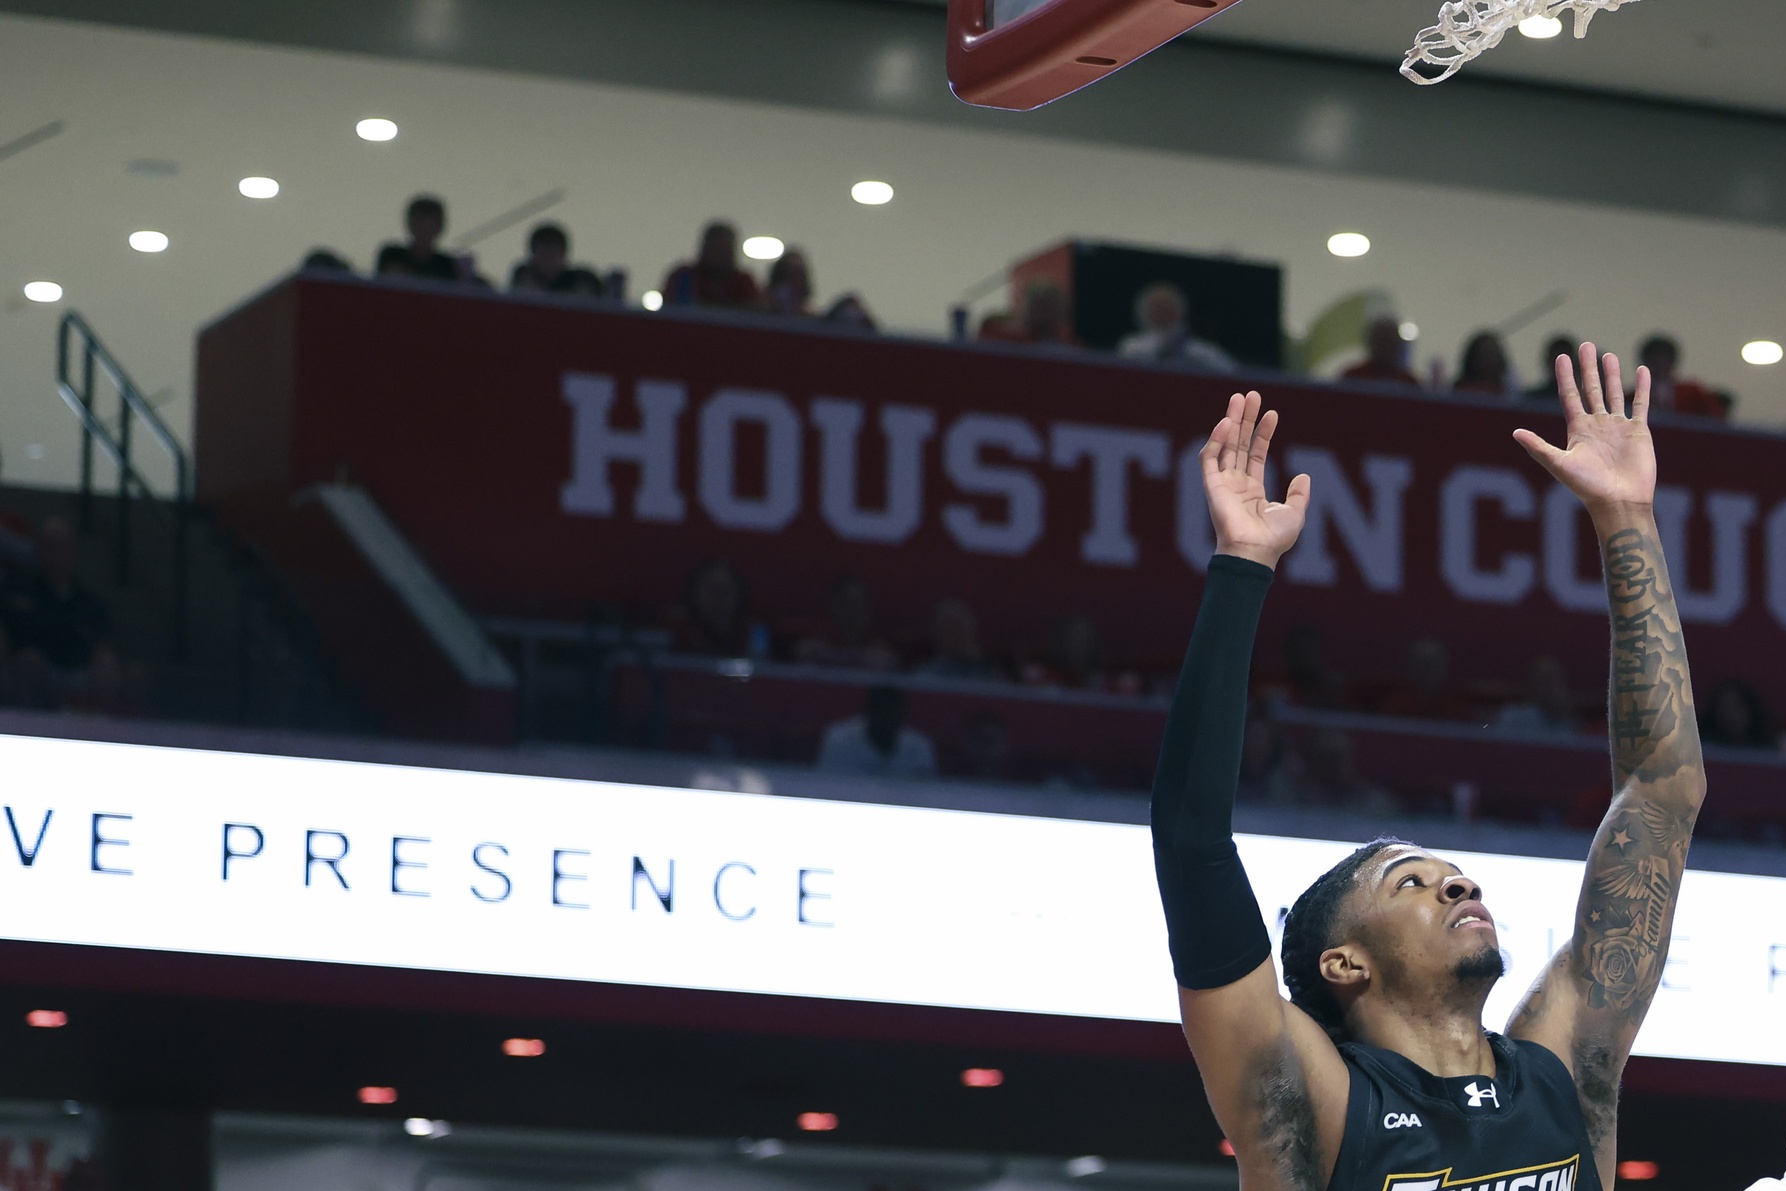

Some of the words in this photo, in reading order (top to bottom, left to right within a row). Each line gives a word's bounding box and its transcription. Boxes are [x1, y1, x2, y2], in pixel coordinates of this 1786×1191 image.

[1607, 526, 1656, 604] GOD
[1614, 604, 1658, 694] FEAR
[222, 821, 836, 928] PRESENCE
[1383, 1112, 1423, 1130] CAA
